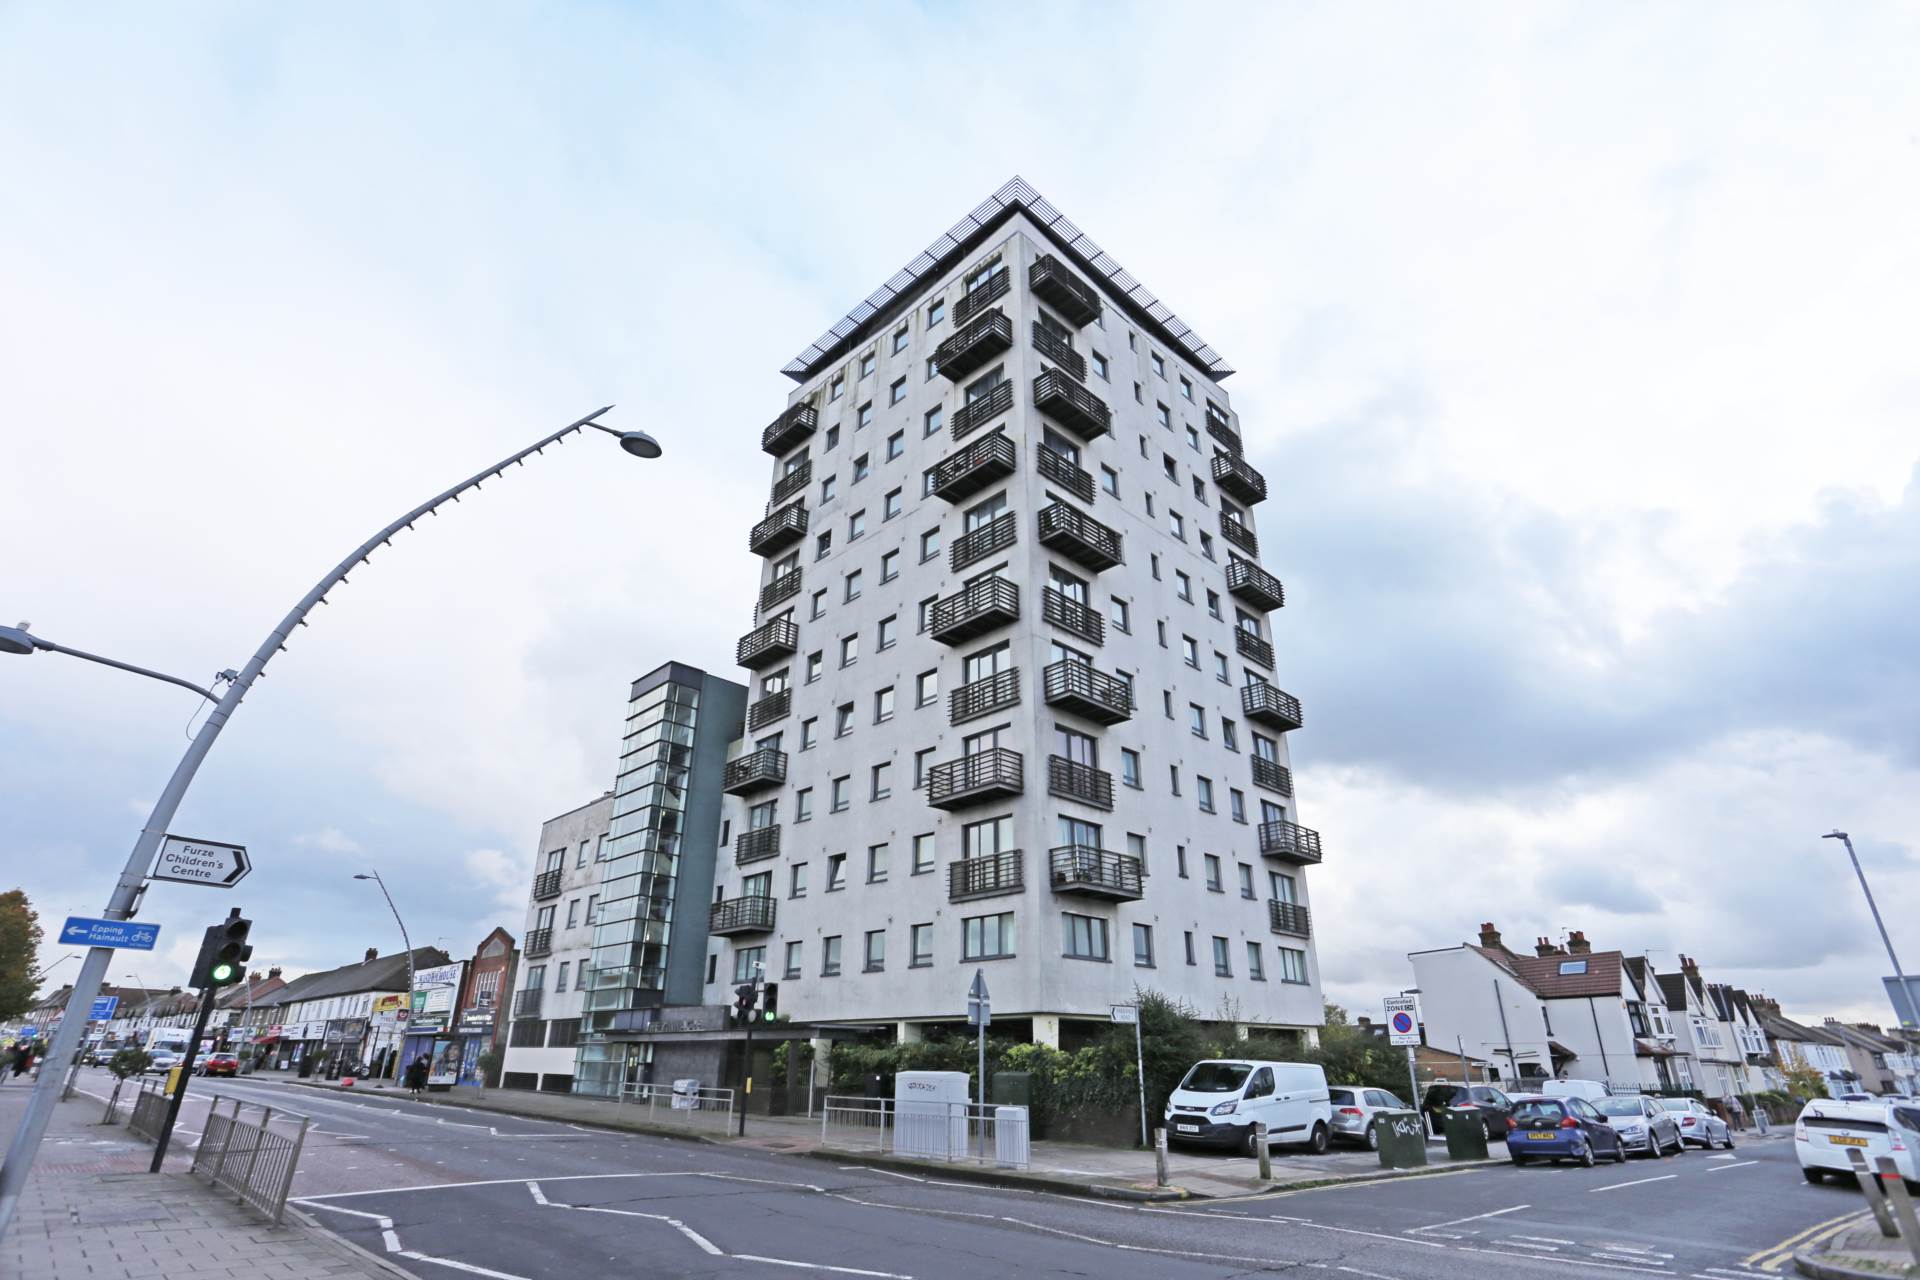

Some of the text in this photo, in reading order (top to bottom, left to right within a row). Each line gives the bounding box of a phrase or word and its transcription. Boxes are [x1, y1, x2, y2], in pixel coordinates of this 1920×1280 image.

[182, 845, 215, 857] Furze
[165, 853, 225, 870] Children's
[171, 865, 212, 878] Centre
[91, 924, 124, 935] Epping
[88, 932, 129, 943] Hainault
